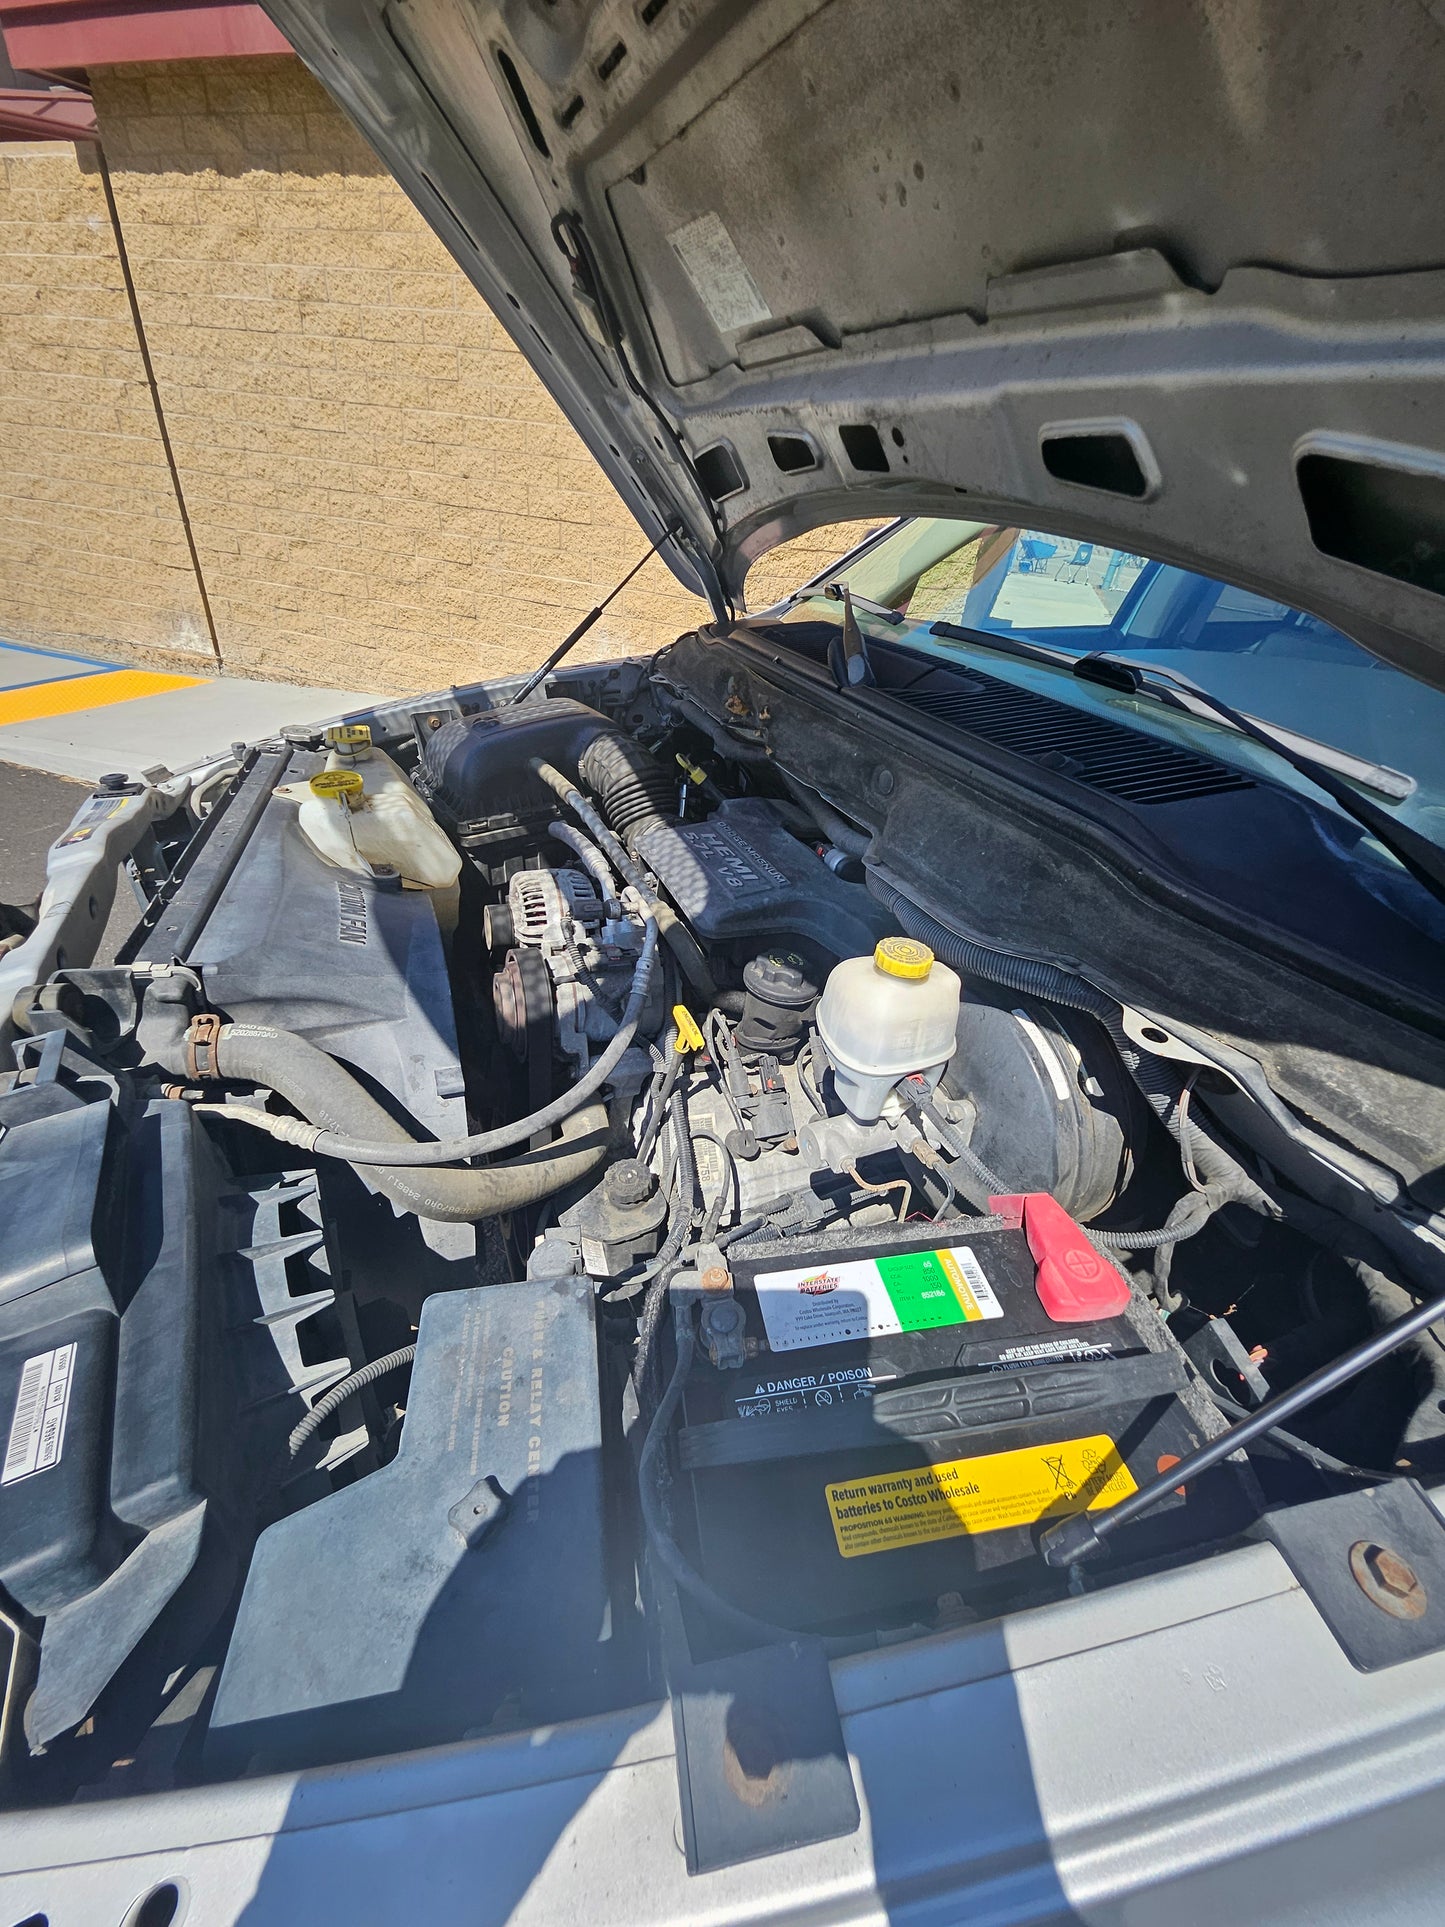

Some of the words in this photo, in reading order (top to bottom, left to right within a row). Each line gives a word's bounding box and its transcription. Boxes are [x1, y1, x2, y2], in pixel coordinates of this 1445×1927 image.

[684, 832, 715, 859] 5.7L
[718, 867, 744, 887] V8
[700, 833, 759, 880] HEMI
[717, 821, 748, 849] DODGE
[745, 847, 786, 883] MAGNUM
[339, 918, 367, 945] FAN
[923, 1260, 932, 1268] 65
[797, 1276, 841, 1289] INTERSTATE
[800, 1283, 838, 1294] BATTERIES
[922, 1274, 939, 1282] 1000
[944, 1258, 974, 1311] AUTOMOTIVE
[921, 1289, 946, 1300] 852186
[497, 1347, 514, 1427] CAUTION
[767, 1376, 817, 1393] DANGER
[828, 1367, 873, 1383] POISON
[529, 1368, 543, 1427] RELAY
[775, 1398, 798, 1407] SHIELD
[526, 1436, 541, 1524] CENTER
[832, 1488, 867, 1502] Return
[868, 1478, 913, 1497] warranty
[915, 1473, 933, 1487] and
[935, 1468, 959, 1484] used
[835, 1502, 882, 1520] batteries
[883, 1499, 894, 1512] to
[895, 1492, 927, 1508] Costco
[927, 1482, 980, 1503] Wholesale
[1064, 1491, 1077, 1501] Pb
[840, 1519, 884, 1533] PROPOSITION
[884, 1516, 893, 1524] 65
[893, 1511, 926, 1522] WARNING:
